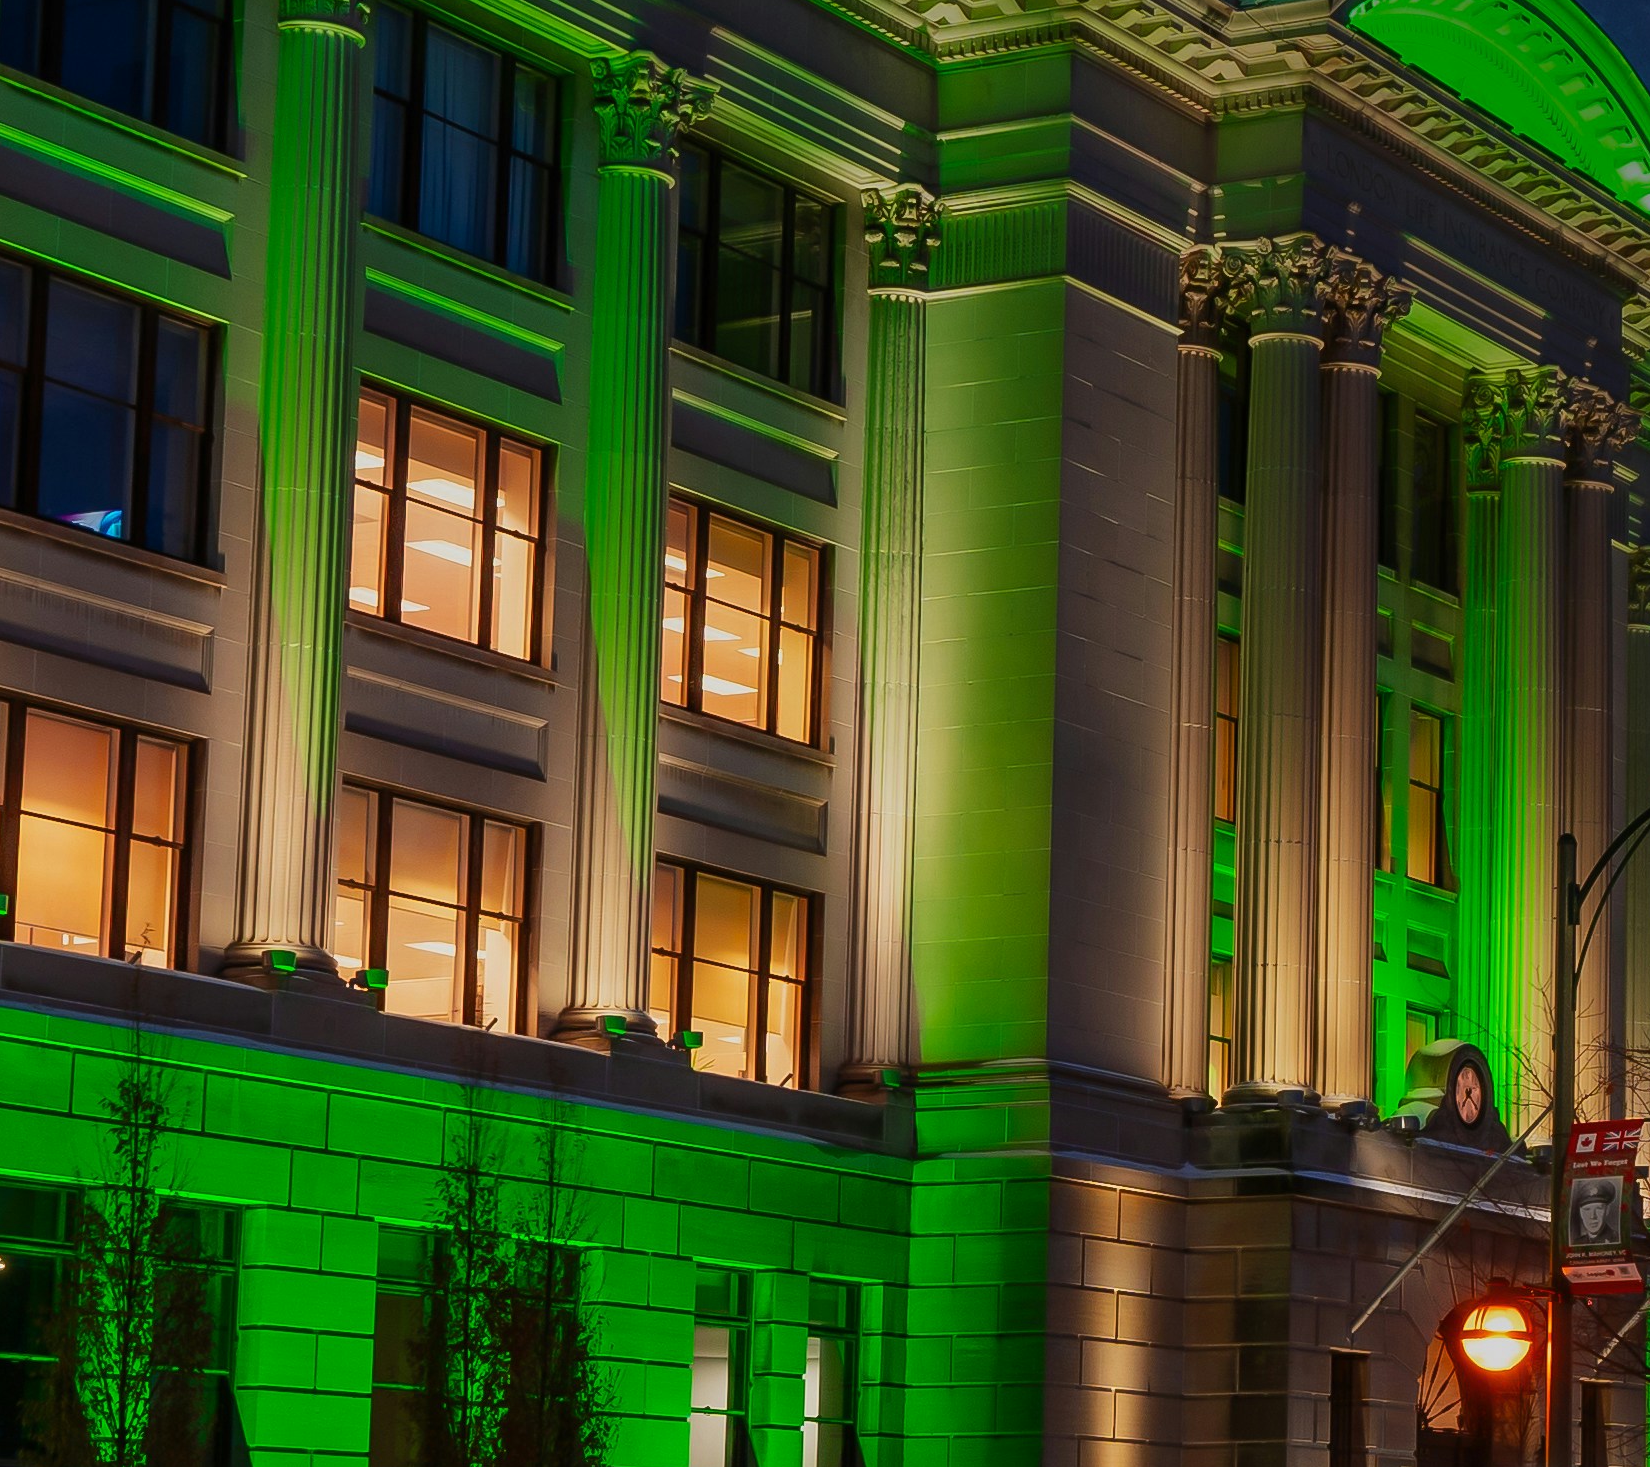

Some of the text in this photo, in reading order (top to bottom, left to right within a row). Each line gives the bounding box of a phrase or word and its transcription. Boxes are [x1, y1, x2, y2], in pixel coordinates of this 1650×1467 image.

[1326, 144, 1606, 324] LONDON LIFE INSURANCE COMPANY
